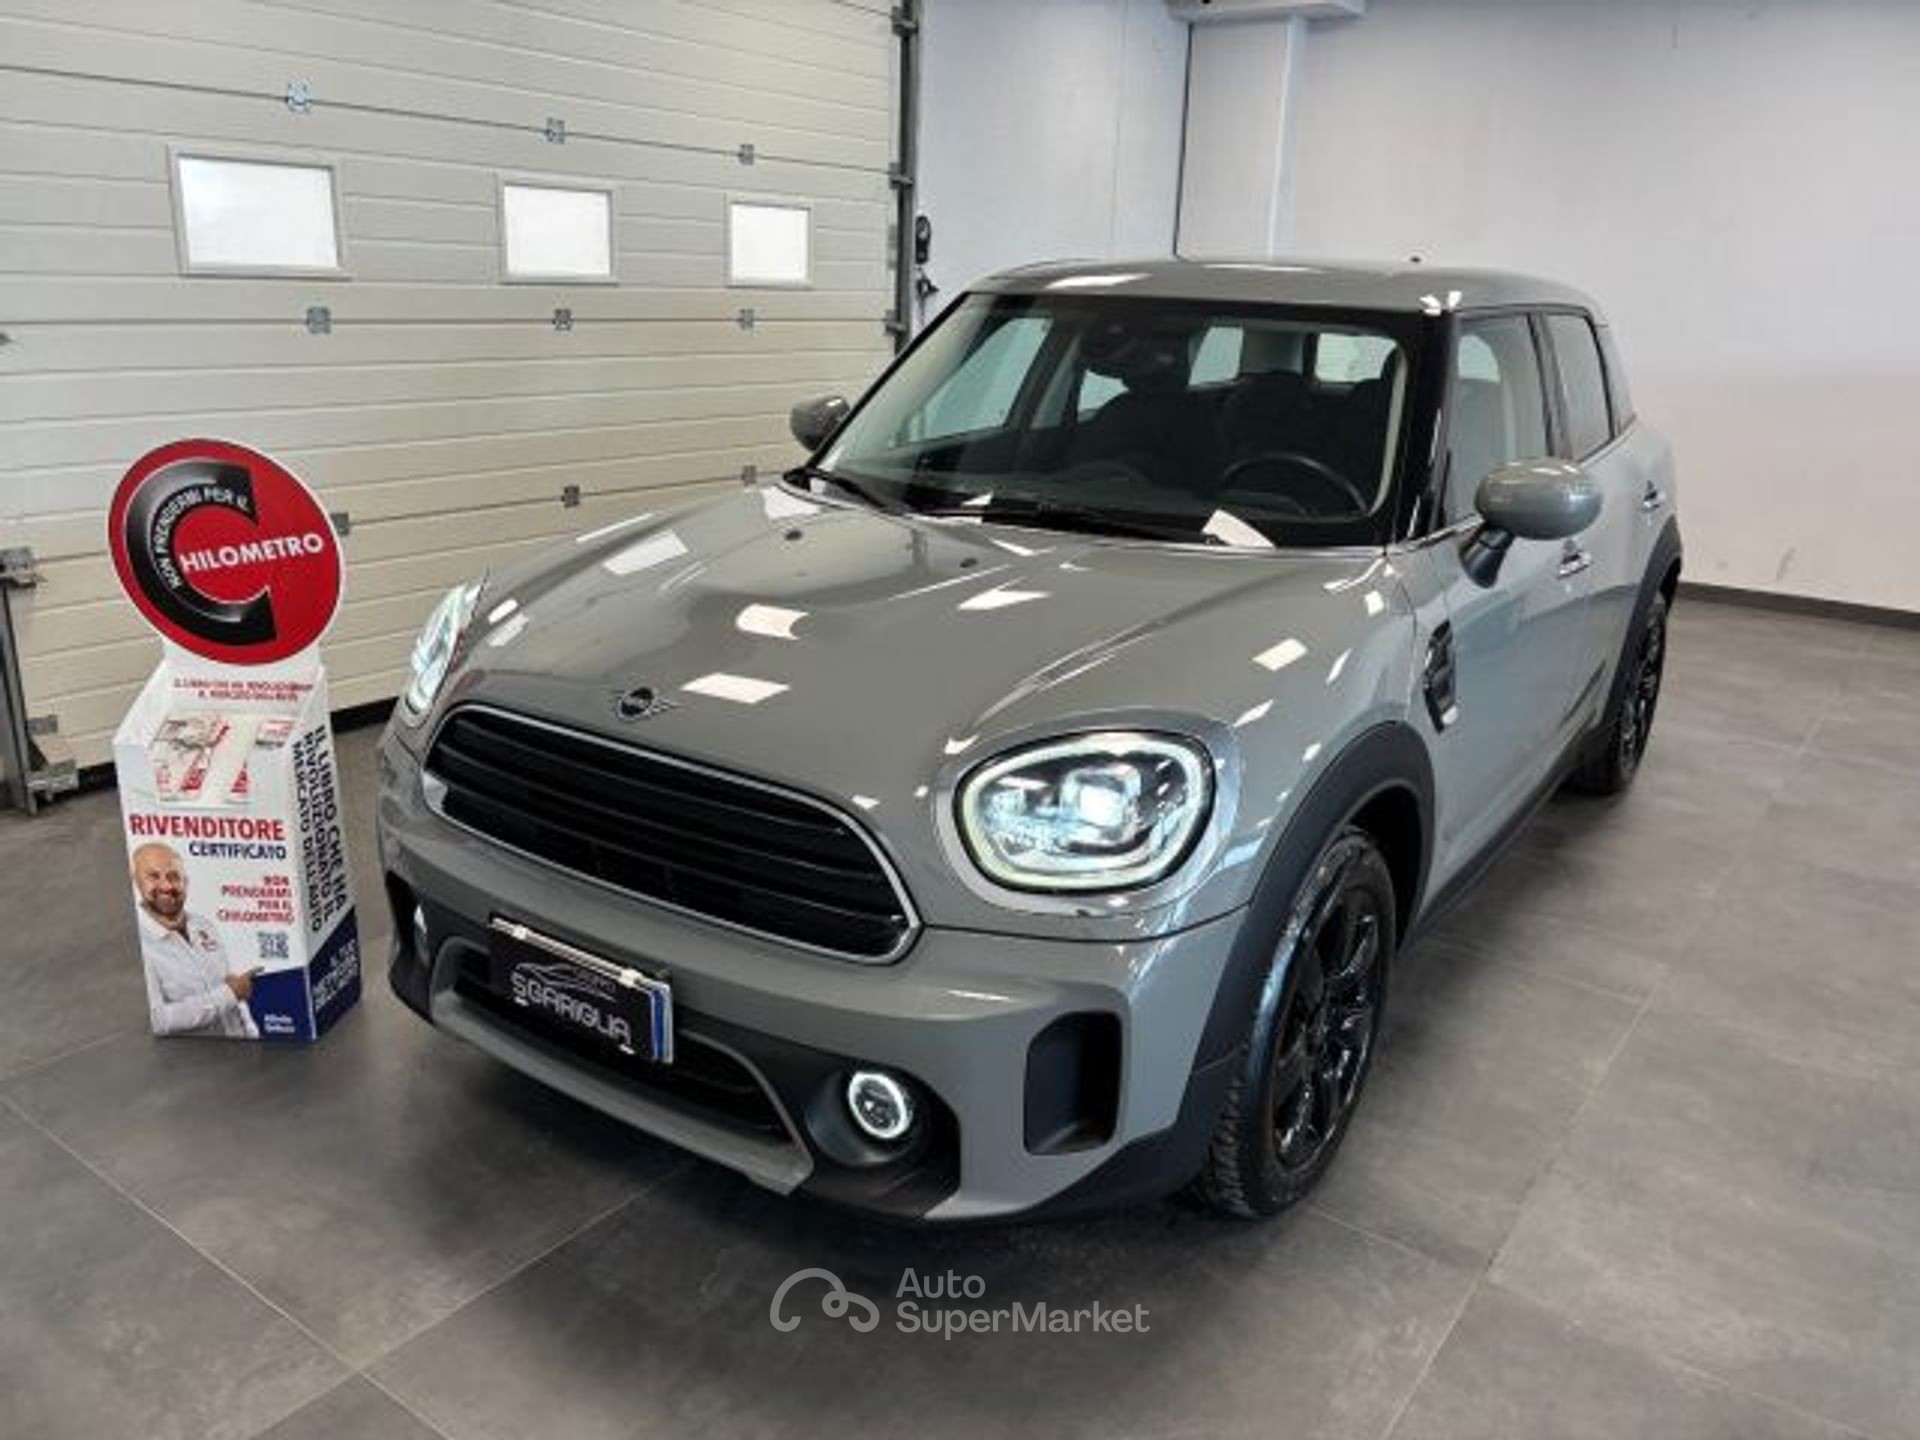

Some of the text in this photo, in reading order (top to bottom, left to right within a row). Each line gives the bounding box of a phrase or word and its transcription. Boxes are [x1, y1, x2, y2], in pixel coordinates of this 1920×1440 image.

[179, 532, 324, 573] HILOMETRO
[319, 750, 337, 820] LIBRO
[129, 814, 286, 842] RIVENDITORE
[326, 824, 344, 872] CHE
[188, 842, 287, 860] CERTIFICATO
[332, 872, 348, 911] HA
